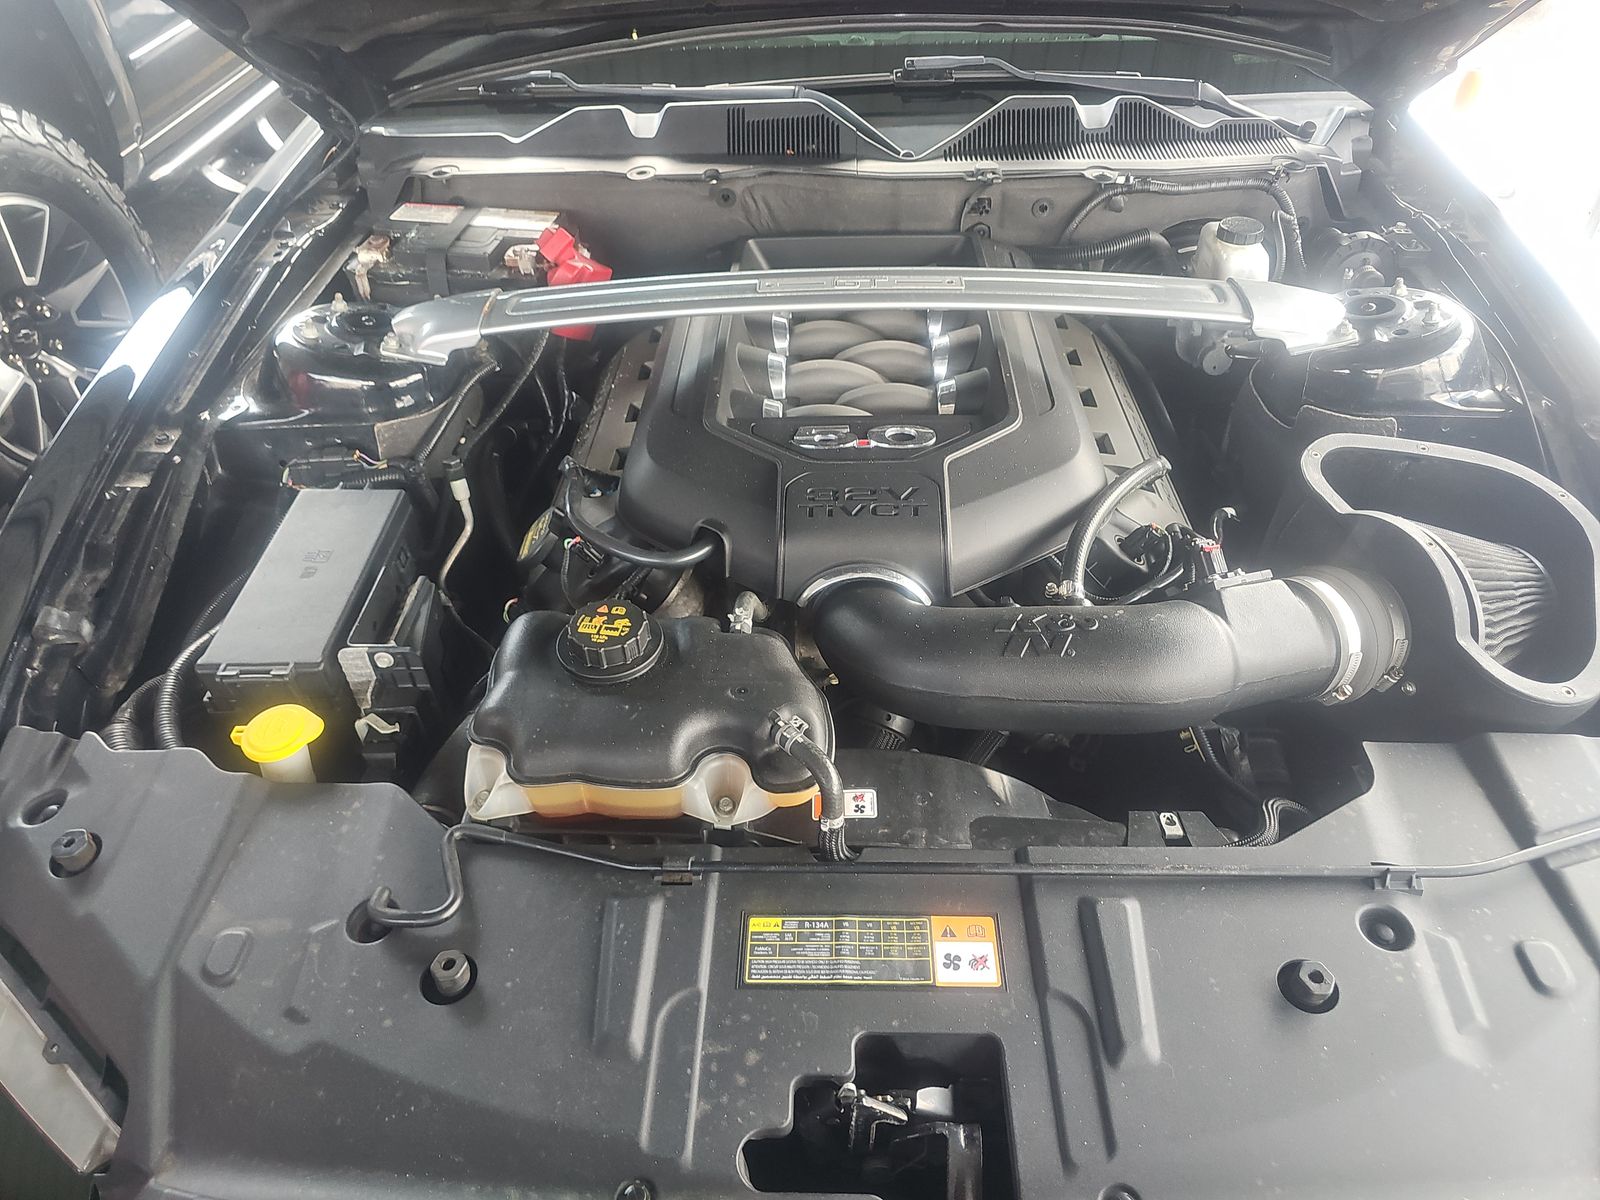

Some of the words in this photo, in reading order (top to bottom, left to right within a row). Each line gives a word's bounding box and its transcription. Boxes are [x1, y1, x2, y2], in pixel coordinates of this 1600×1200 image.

[790, 424, 937, 449] 5.0
[806, 486, 920, 502] 32V
[804, 921, 830, 929] R-134A
